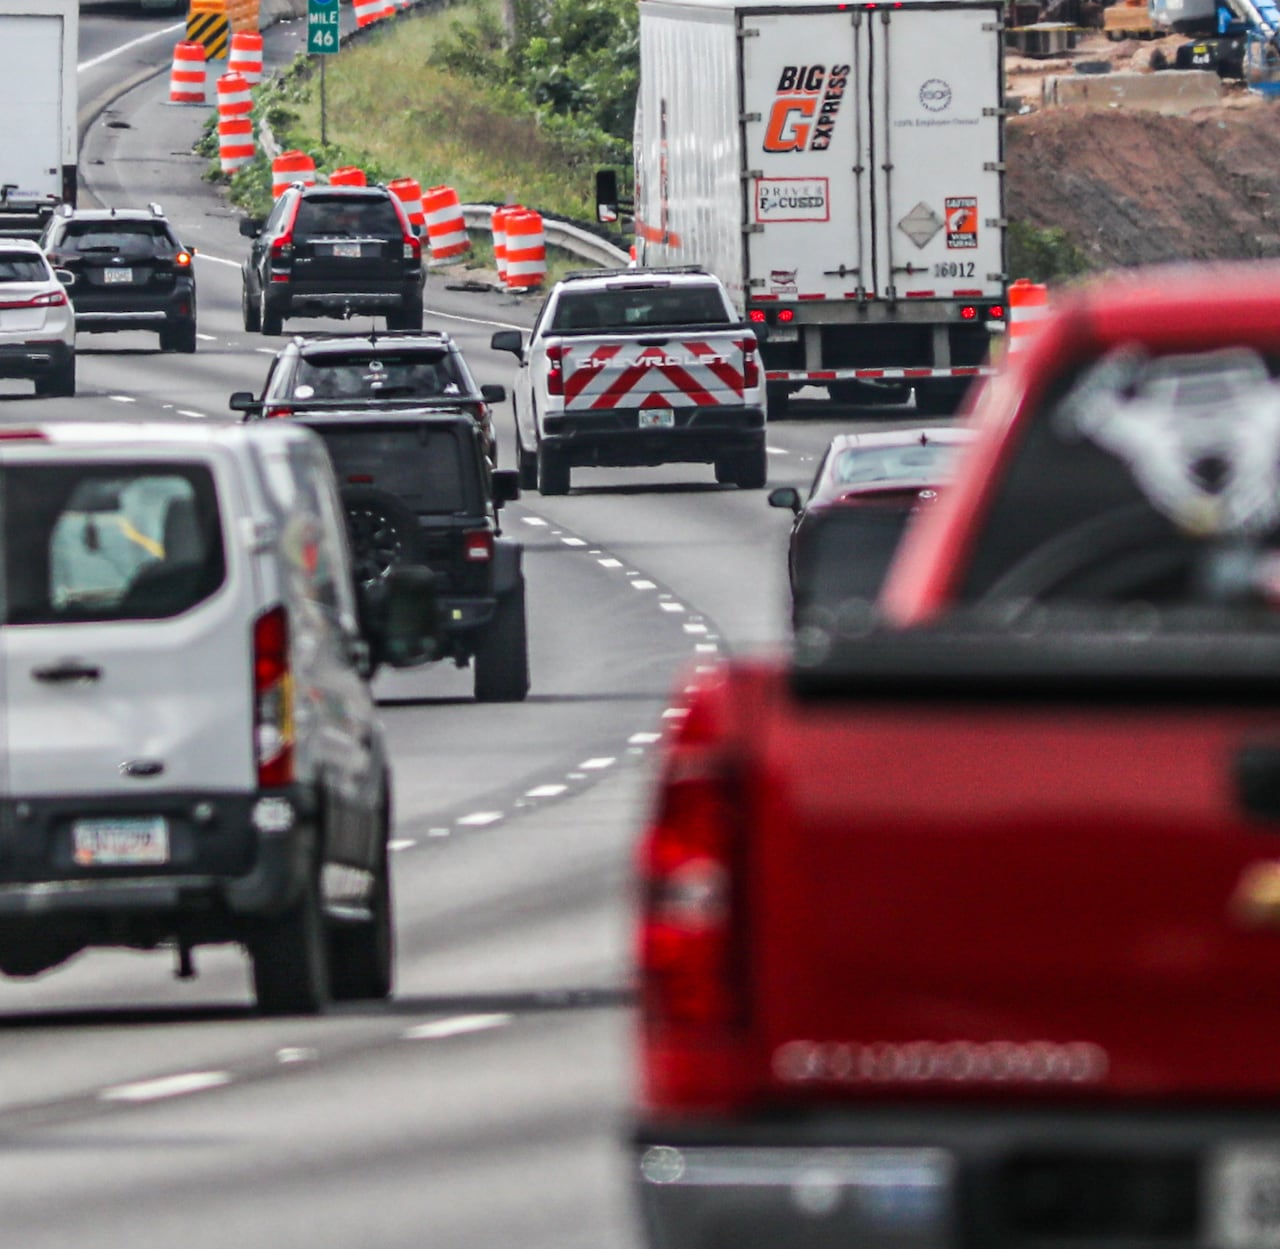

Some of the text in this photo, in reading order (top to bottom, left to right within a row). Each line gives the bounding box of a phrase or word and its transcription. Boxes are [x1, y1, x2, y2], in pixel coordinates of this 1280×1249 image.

[310, 12, 337, 25] MILE
[313, 30, 334, 47] 46
[777, 65, 825, 94] BIG
[810, 64, 851, 151] EXPRESS
[763, 98, 816, 153] G
[760, 198, 824, 210] FCUSED
[934, 262, 975, 278] 16012
[575, 354, 731, 368] CHEVROLET
